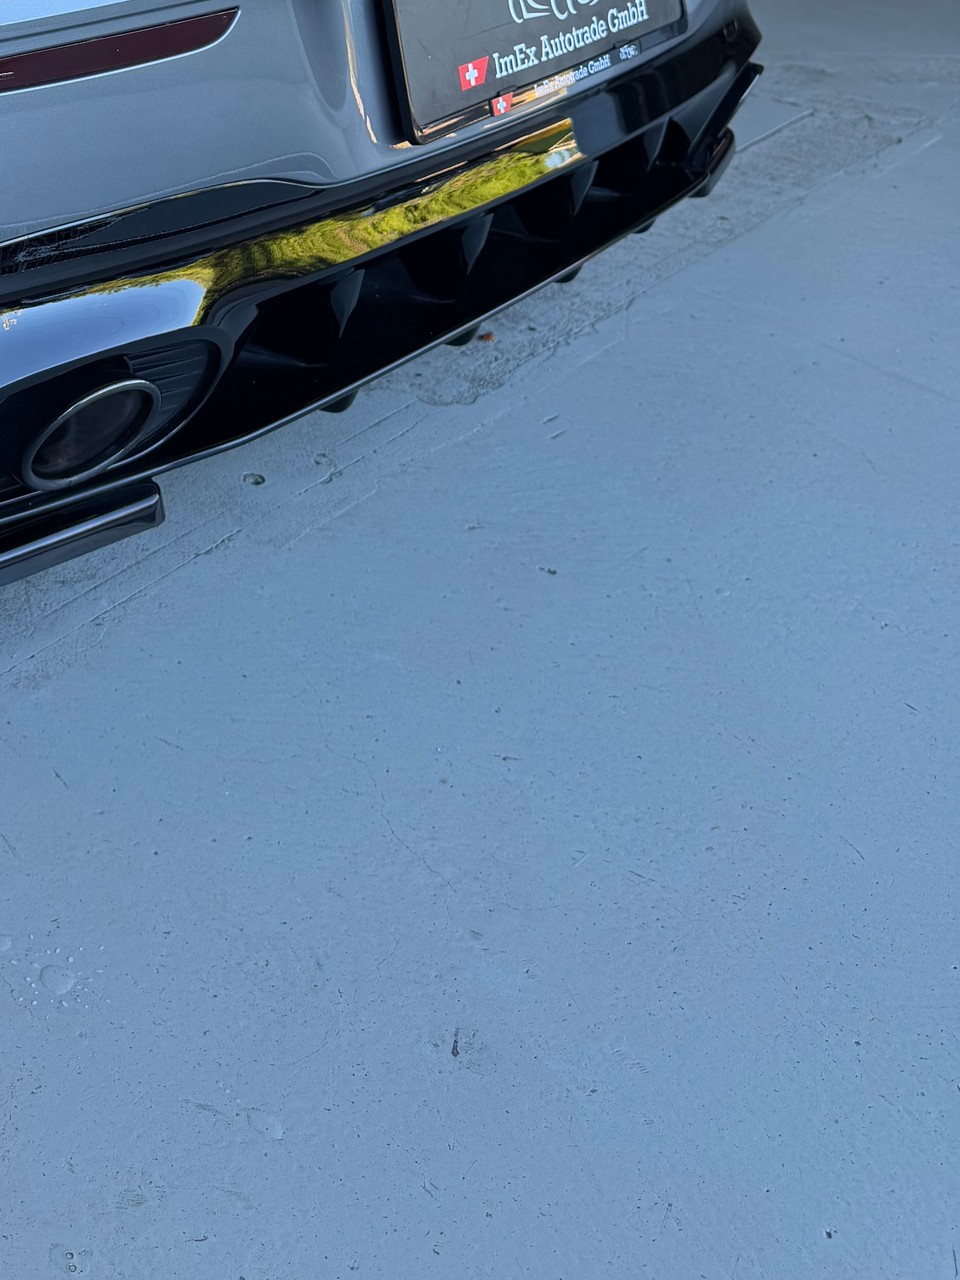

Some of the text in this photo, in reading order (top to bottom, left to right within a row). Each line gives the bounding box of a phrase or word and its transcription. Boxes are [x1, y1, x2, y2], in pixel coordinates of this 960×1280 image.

[492, 43, 539, 79] ImEx
[540, 16, 607, 62] Autotrade
[588, 54, 612, 74] GmbH
